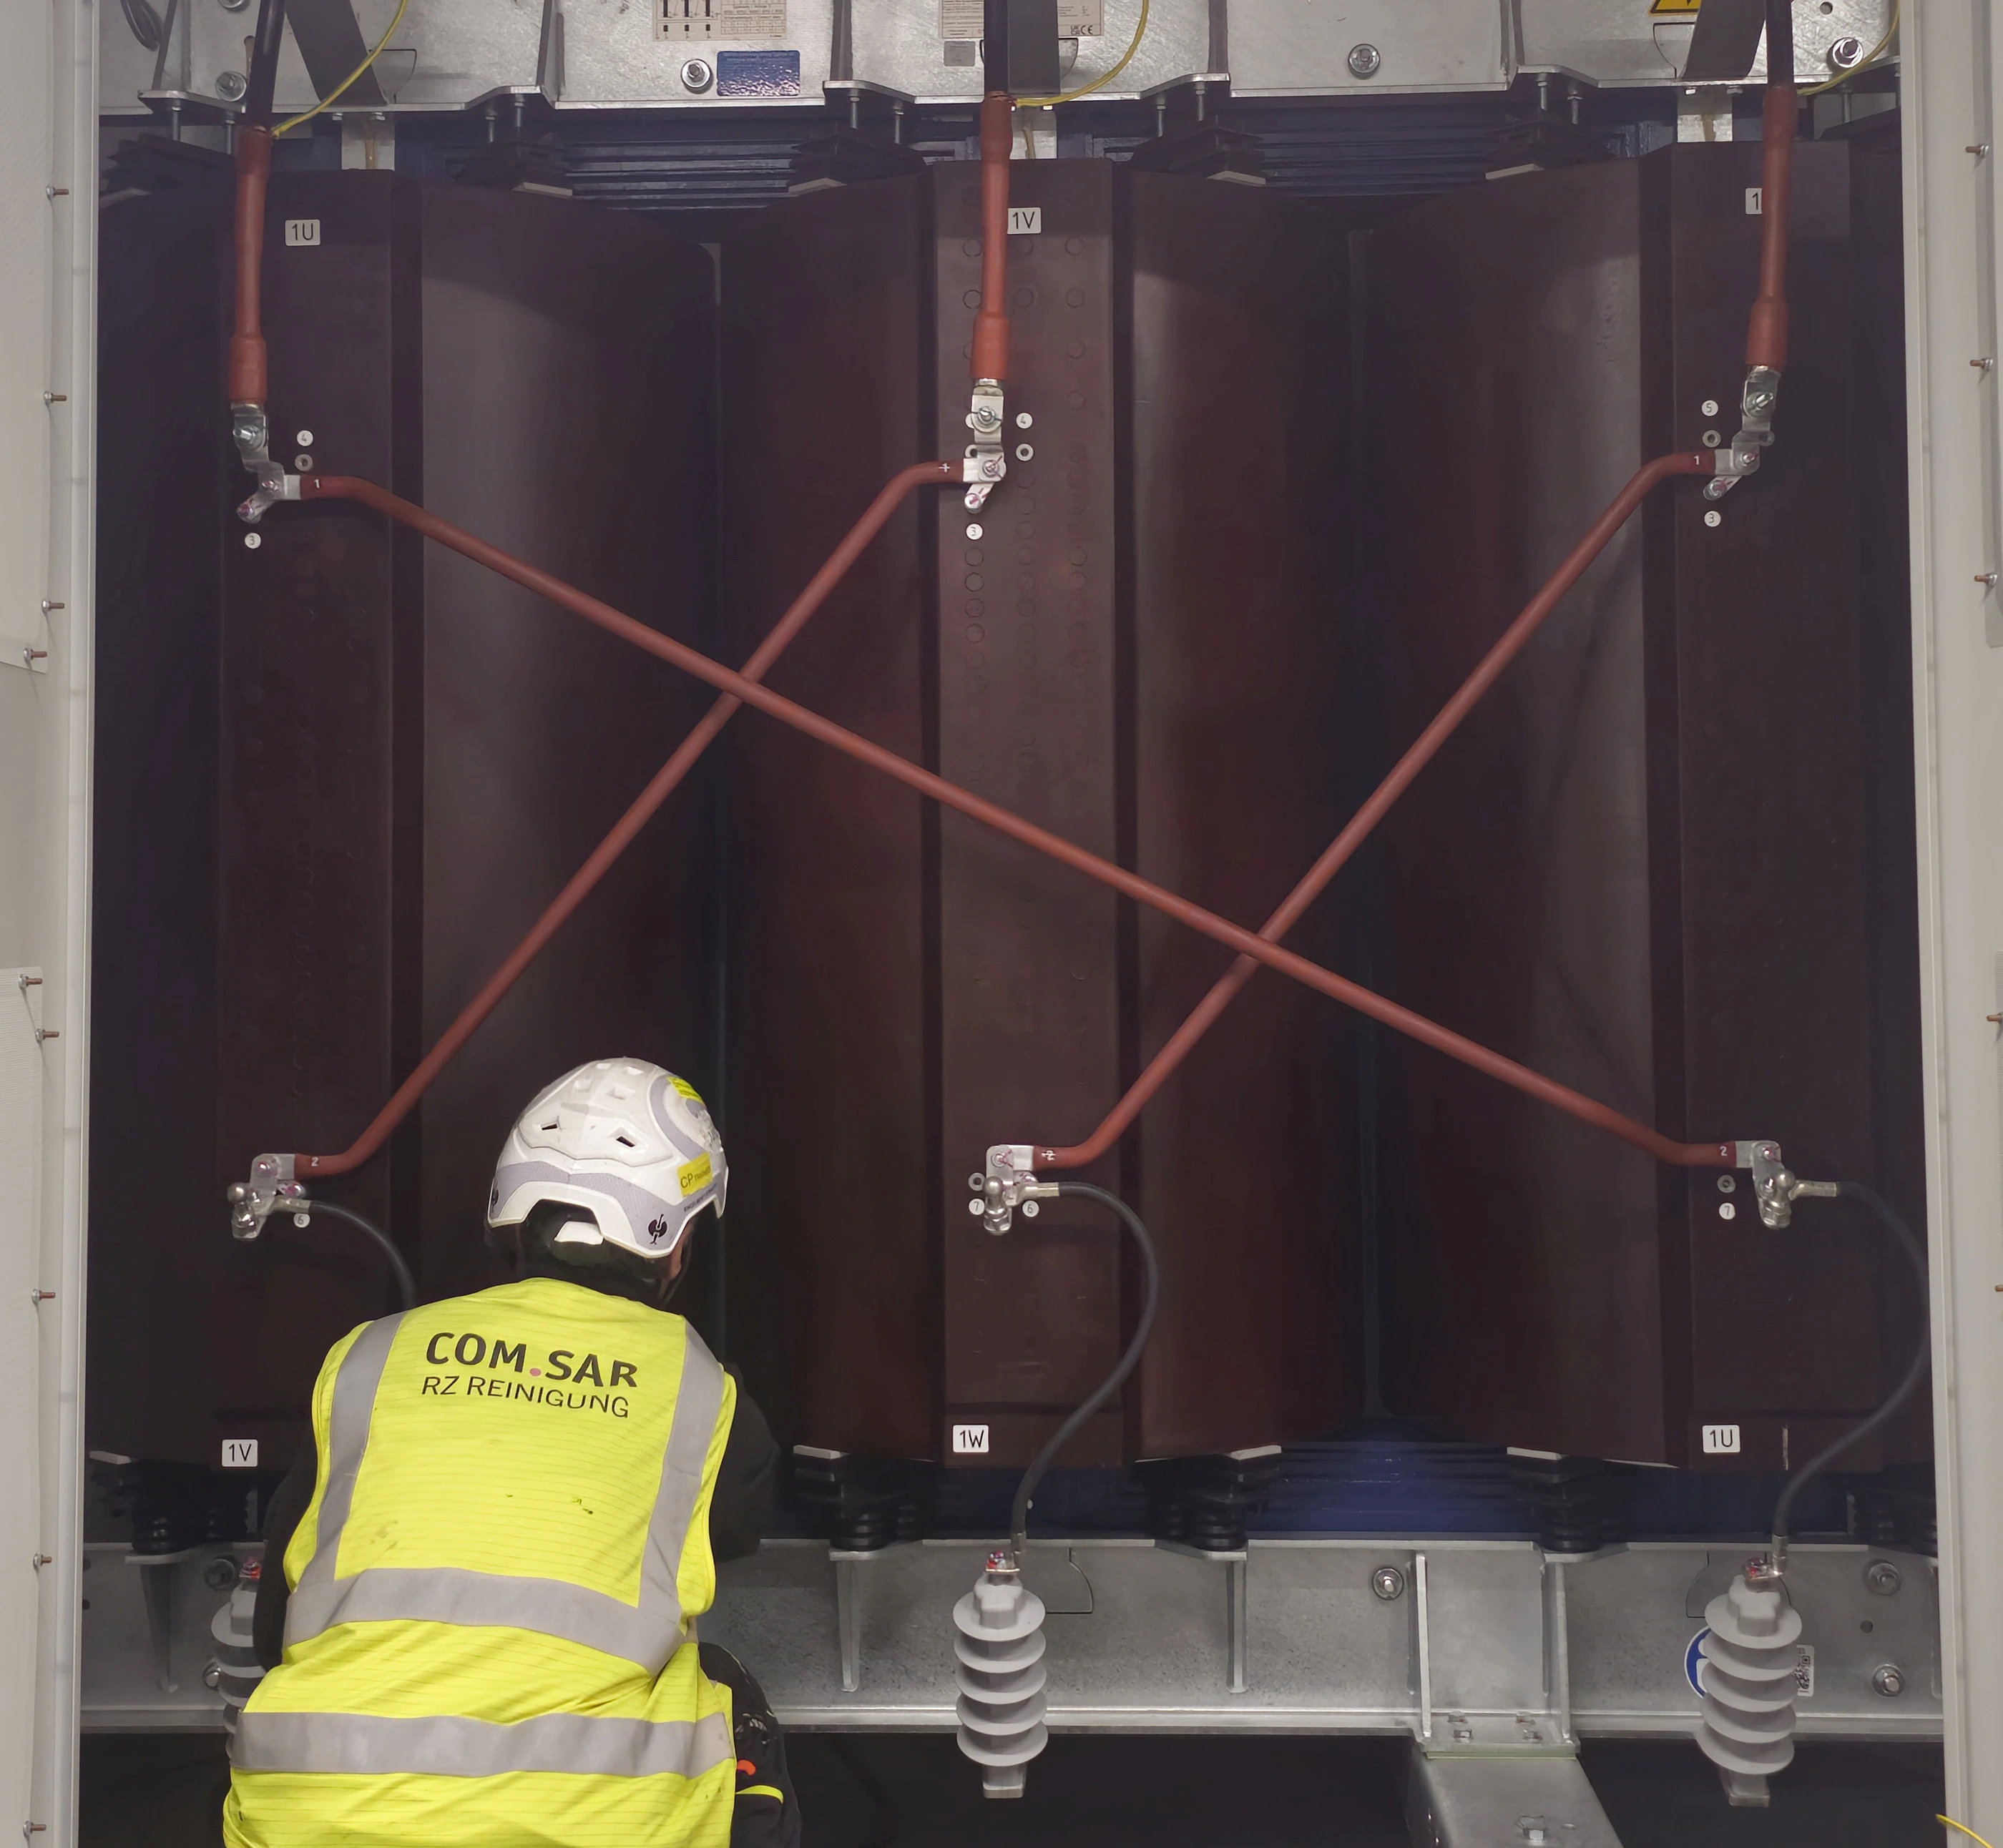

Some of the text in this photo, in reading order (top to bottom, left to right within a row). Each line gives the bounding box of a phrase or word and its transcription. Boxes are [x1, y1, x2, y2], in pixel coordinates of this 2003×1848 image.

[1752, 192, 1759, 210] 1
[1012, 212, 1035, 229] 1V
[291, 222, 313, 240] 1U
[1706, 403, 1713, 413] 5
[1694, 455, 1700, 465] 1
[313, 478, 320, 489] 1
[1708, 513, 1715, 524] 3
[970, 526, 976, 536] 3
[1720, 1146, 1728, 1156] 2
[311, 1156, 319, 1167] 2
[680, 1172, 693, 1189] CP
[974, 1201, 979, 1211] 7
[1027, 1204, 1033, 1214] 6
[1724, 1205, 1730, 1217] 7
[297, 1215, 304, 1225] 6
[426, 1332, 637, 1387] COM.SAR
[421, 1375, 629, 1418] RZ REINIGUNG
[959, 1430, 984, 1448] 1W
[1709, 1429, 1733, 1448] 1U
[228, 1443, 252, 1462] 1V
